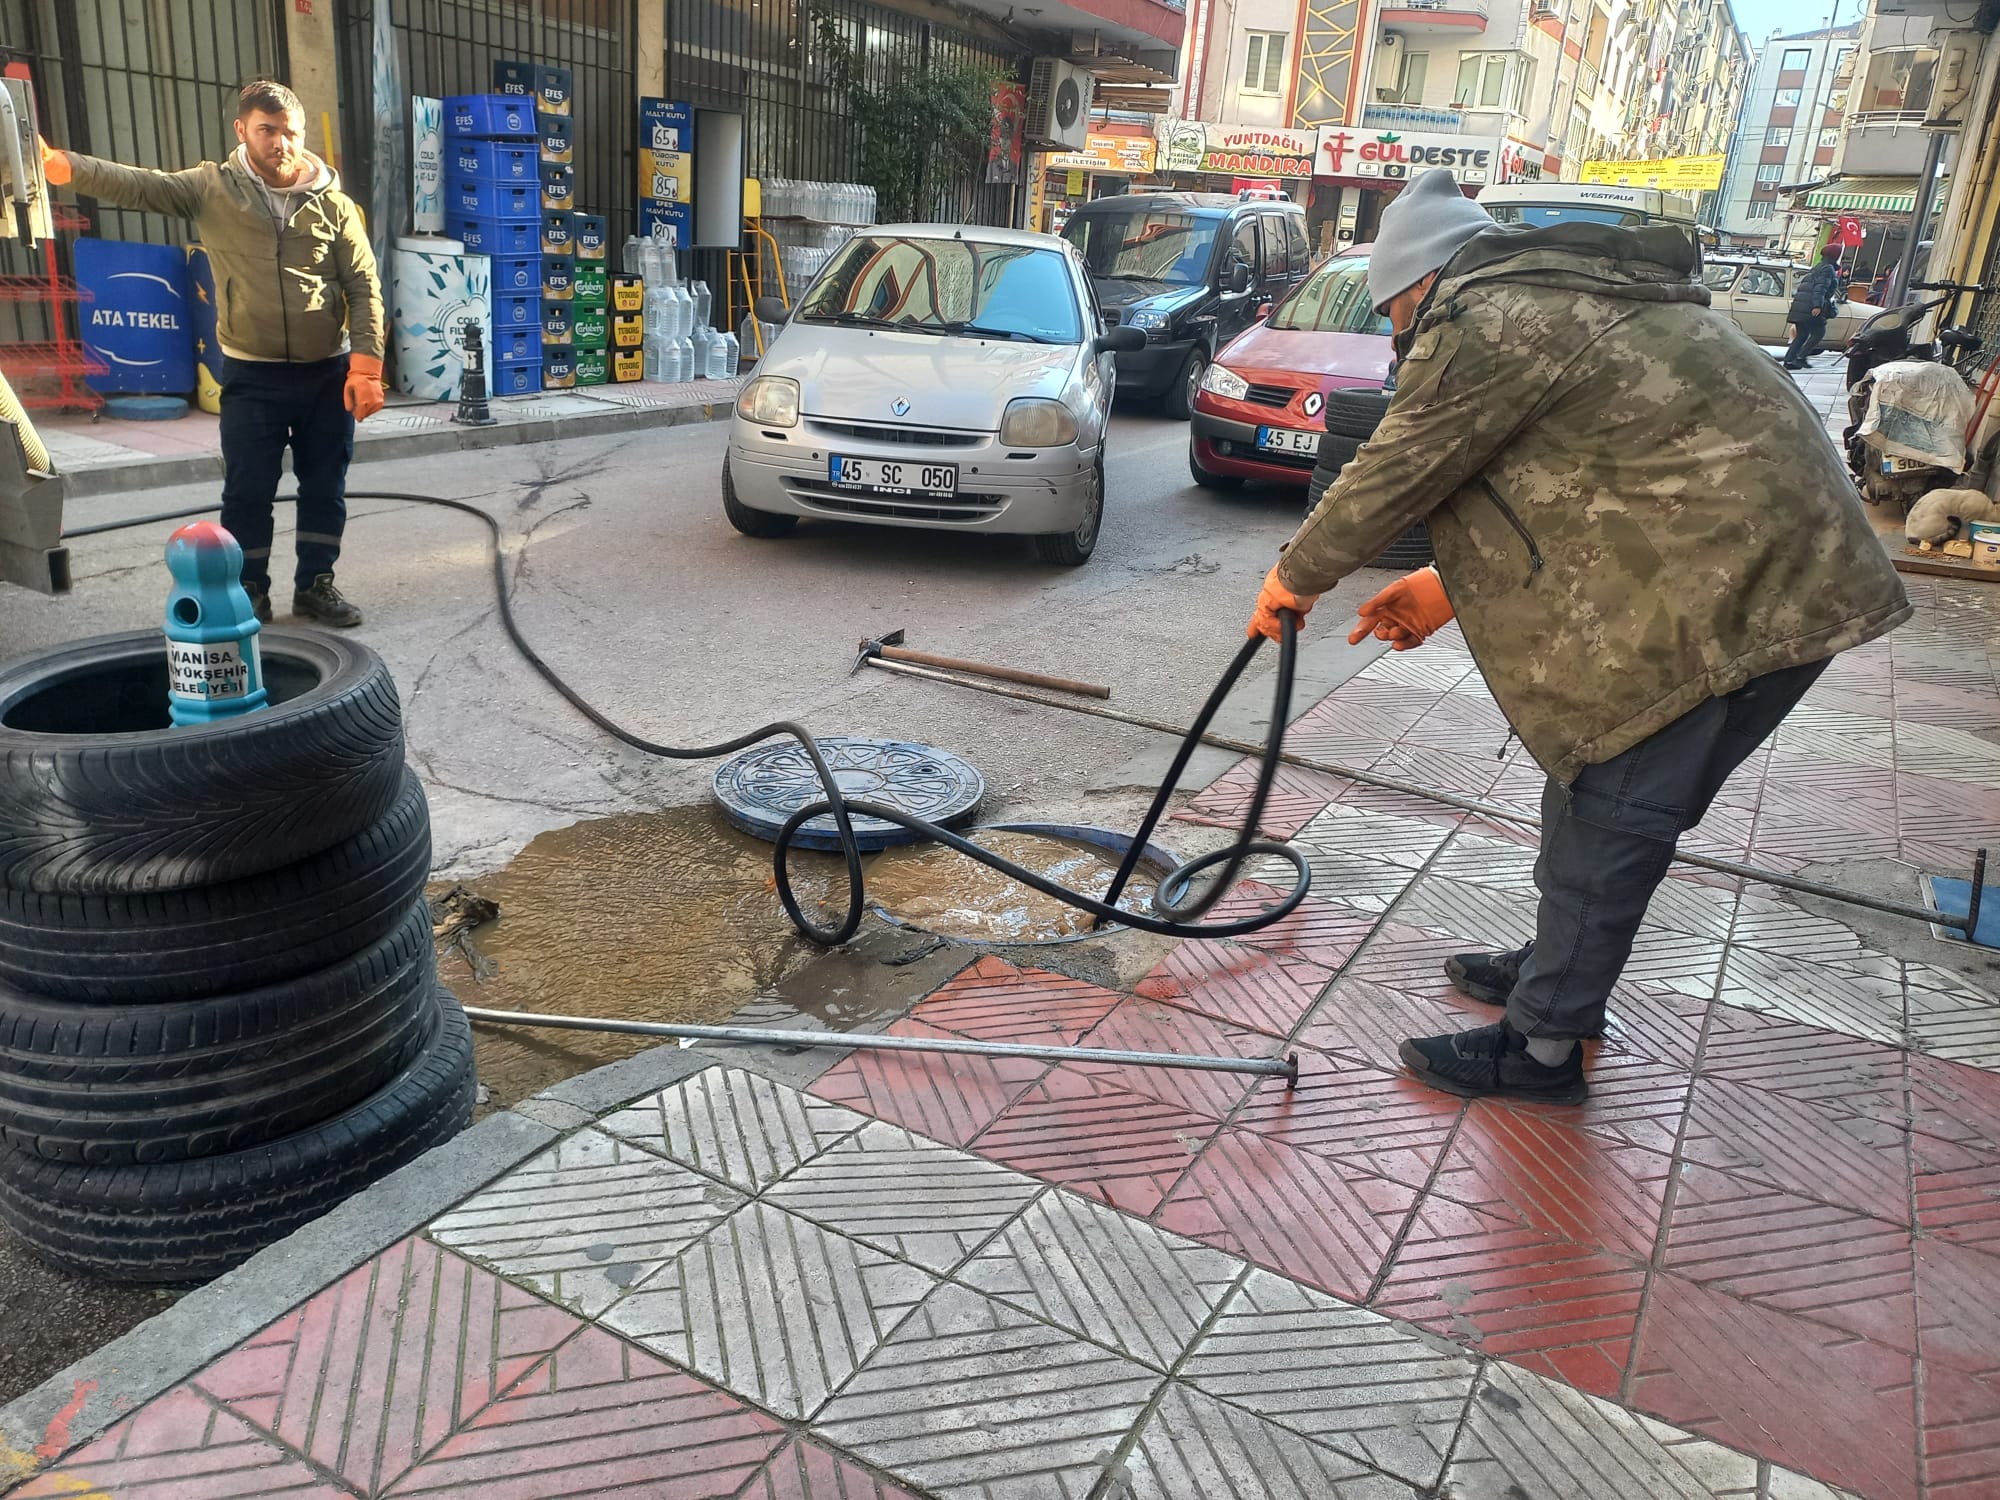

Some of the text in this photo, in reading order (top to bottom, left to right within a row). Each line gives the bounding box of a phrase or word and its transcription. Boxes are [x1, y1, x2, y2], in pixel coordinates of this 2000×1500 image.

[504, 83, 524, 95] EFES
[544, 88, 563, 100] EFES
[455, 115, 473, 126] EFES
[645, 110, 686, 120] MALT KUTU
[654, 128, 670, 145] 65
[547, 138, 566, 148] EFES
[1223, 132, 1303, 154] YUNTDAĞLI
[459, 157, 478, 169] EFES
[1208, 152, 1312, 175] MANDIRA
[548, 184, 567, 195] EFES
[655, 176, 671, 197] 85
[1580, 191, 1634, 202] WESTFALIA
[664, 209, 684, 218] KUTU
[463, 232, 482, 244] EFES
[548, 230, 567, 241] EFES
[582, 235, 599, 244] EFES
[549, 276, 567, 286] EFES
[574, 278, 604, 294] Carlsberg
[92, 310, 179, 330] ATA TEKEL
[456, 317, 480, 325] COLD
[547, 321, 566, 331] EFES
[575, 321, 604, 335] Carlsberg
[550, 365, 569, 374] EFES
[575, 362, 605, 376] Carlsberg
[1267, 431, 1285, 447] 45
[1293, 434, 1313, 450] EJ
[841, 460, 862, 481] 45
[881, 464, 902, 484] SC
[921, 467, 954, 489] 050
